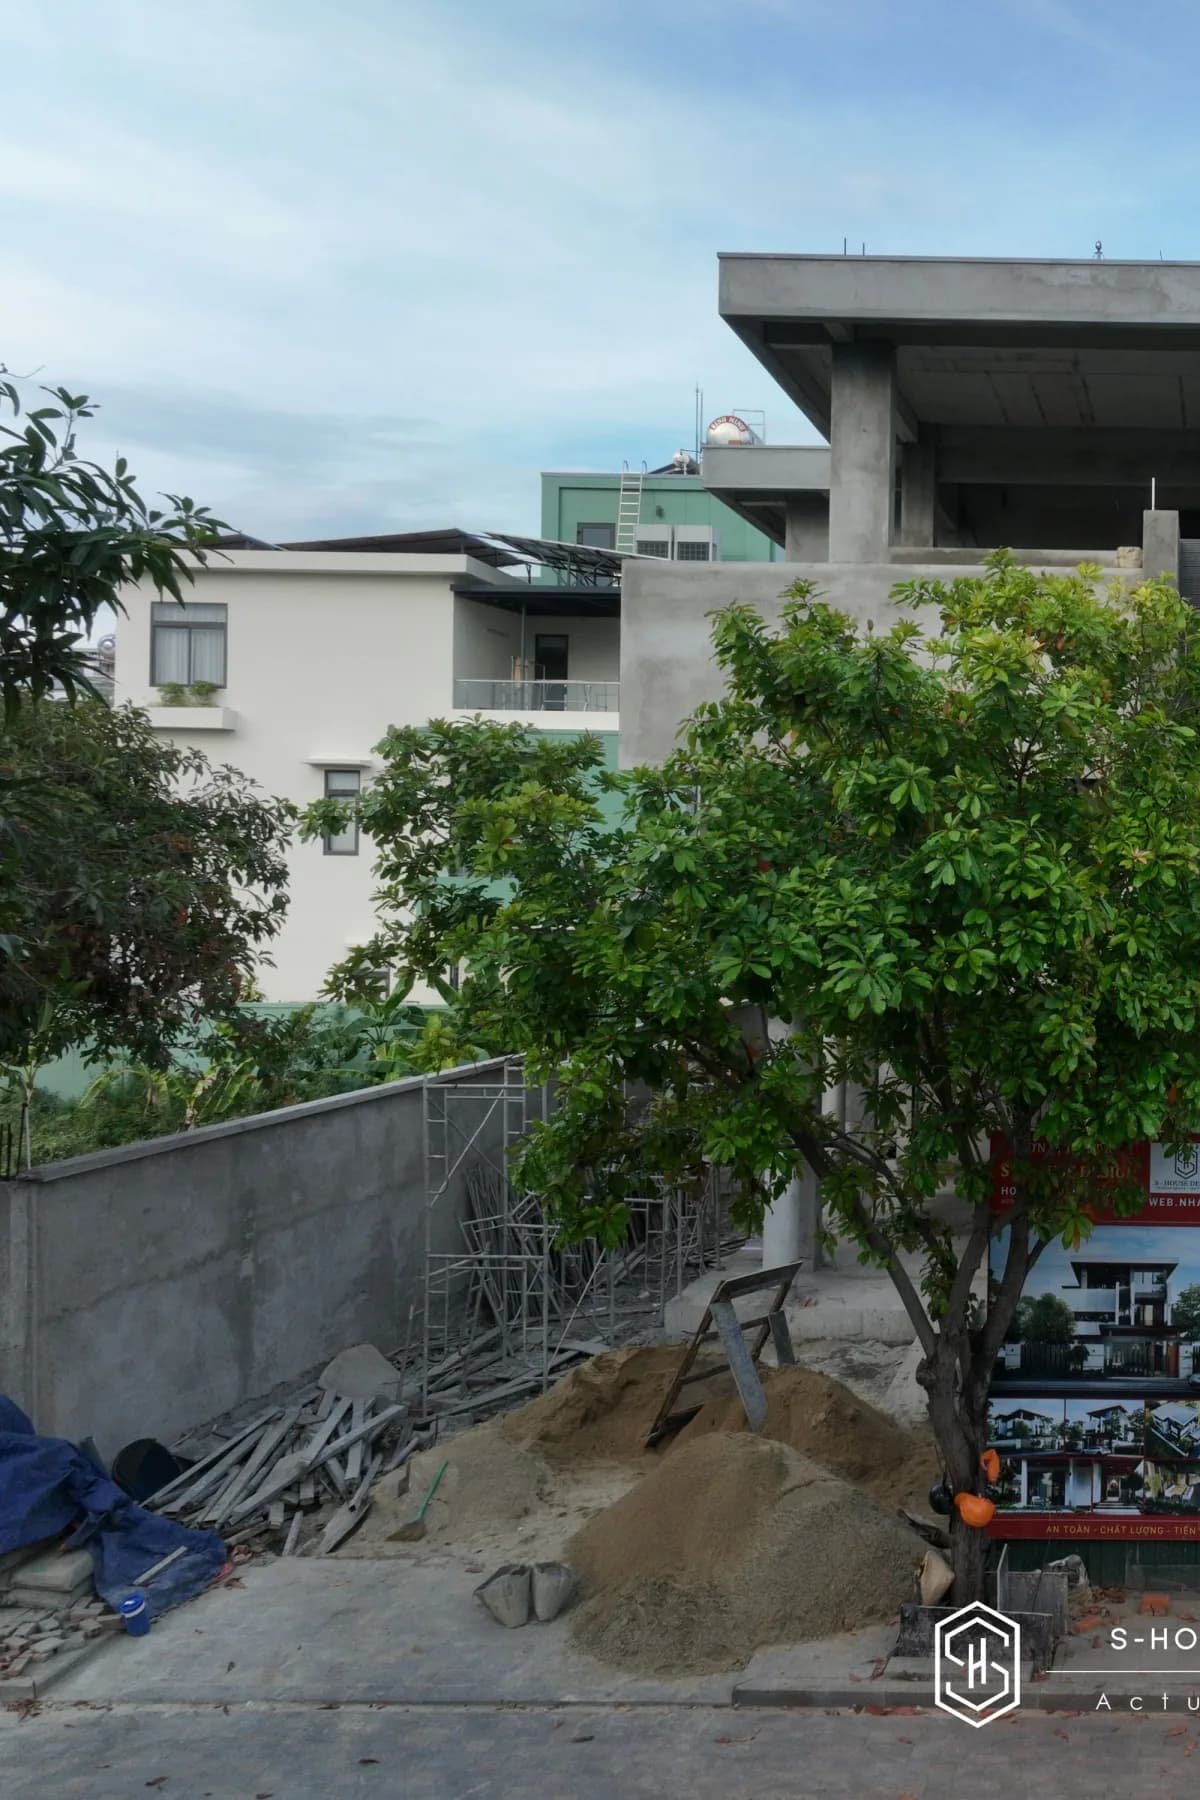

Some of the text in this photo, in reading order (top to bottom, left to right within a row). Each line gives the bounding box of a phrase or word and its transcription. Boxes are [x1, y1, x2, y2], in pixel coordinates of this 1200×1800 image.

[1046, 1525, 1060, 1533] AN
[1063, 1524, 1090, 1534] TOÀN
[1100, 1523, 1127, 1535] CHẤT
